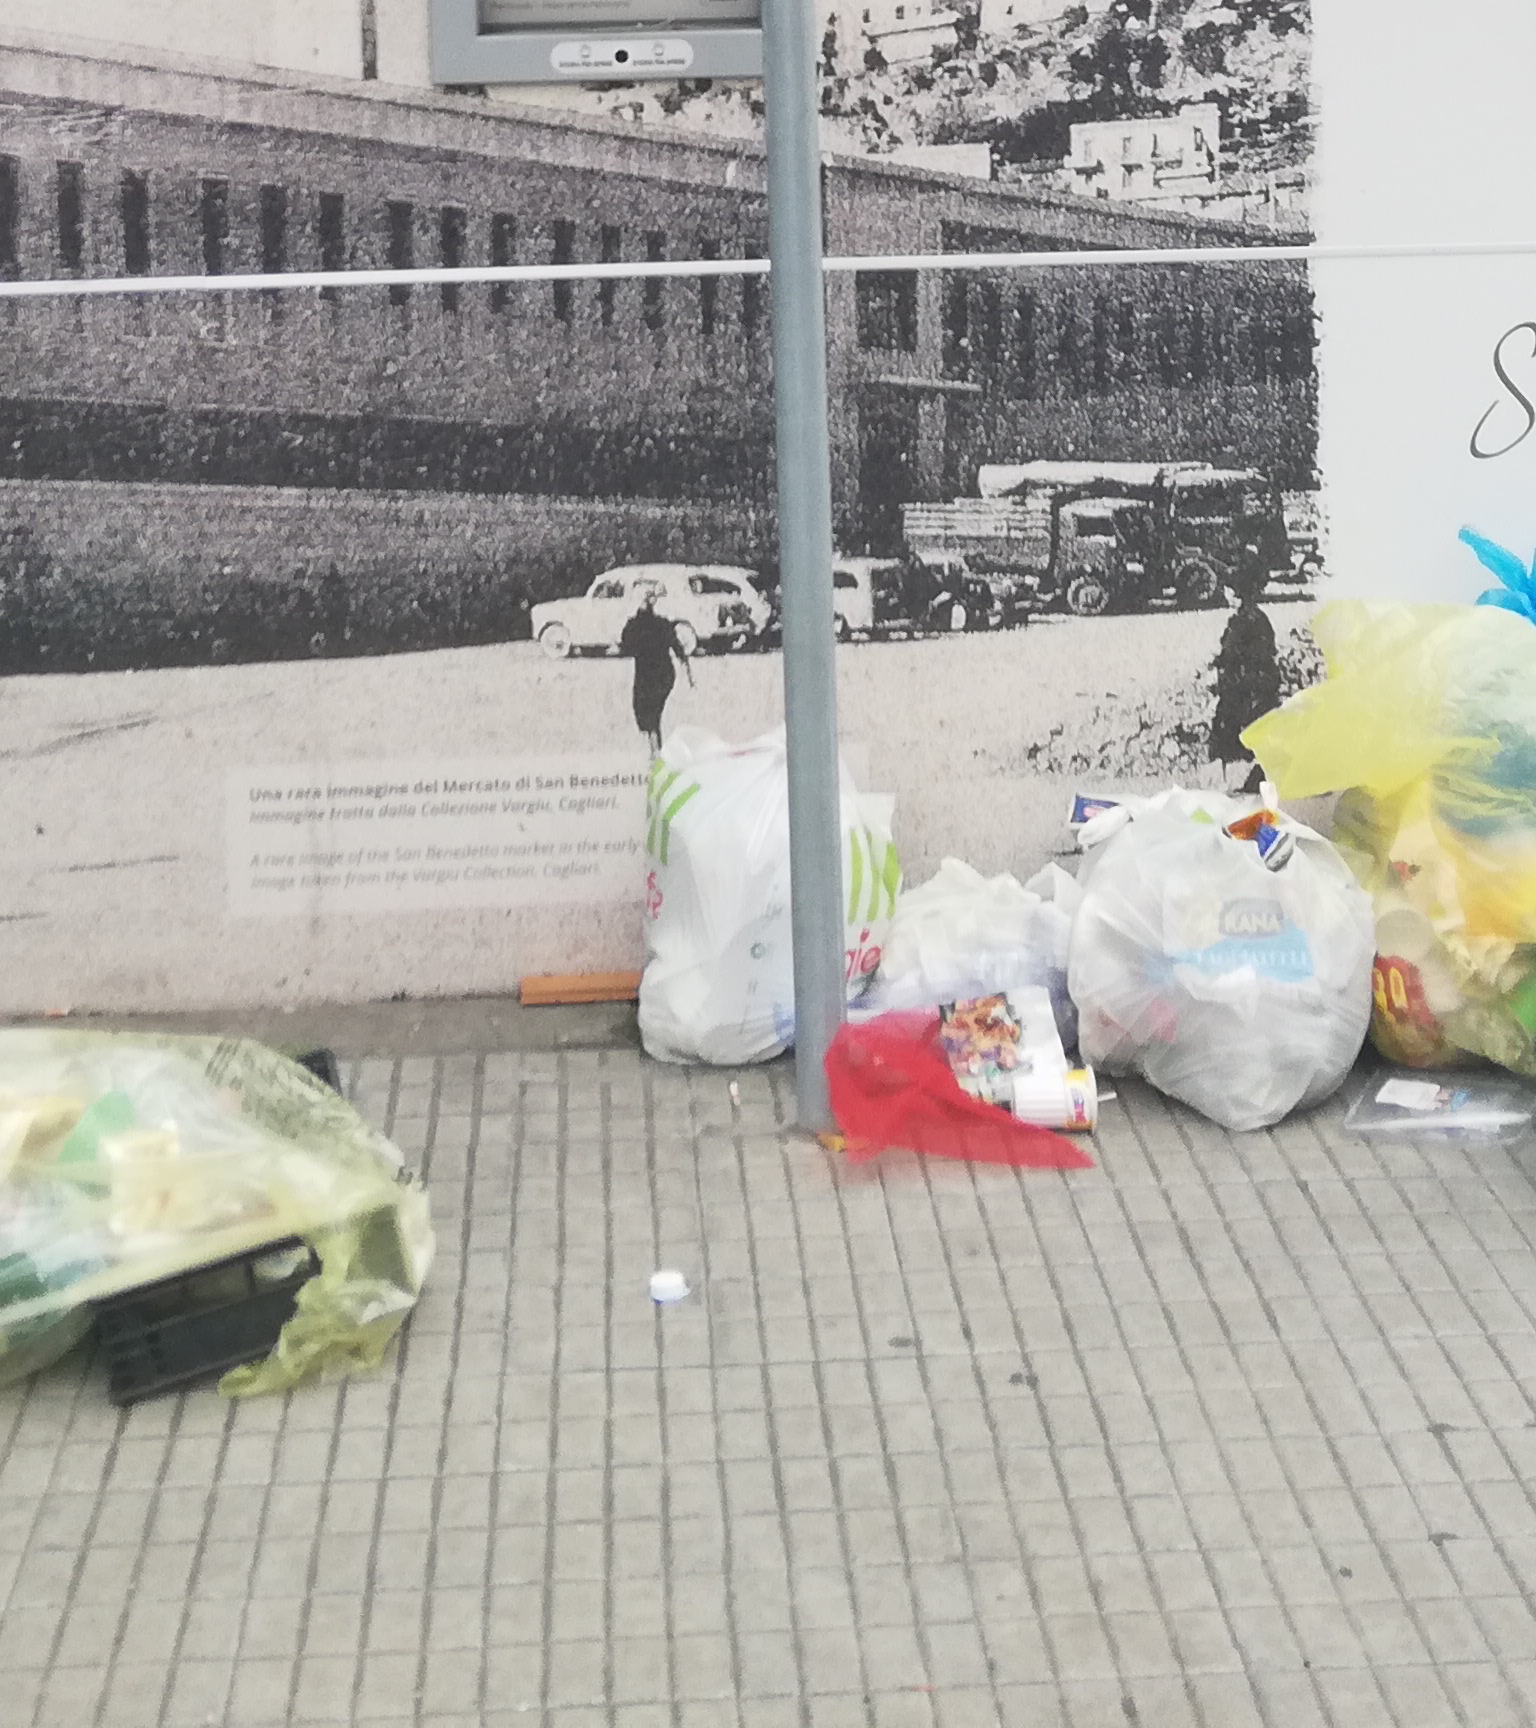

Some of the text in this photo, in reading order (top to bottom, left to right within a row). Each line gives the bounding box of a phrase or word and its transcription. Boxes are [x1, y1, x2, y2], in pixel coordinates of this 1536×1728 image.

[413, 778, 439, 794] del
[442, 777, 512, 793] Mercato
[515, 775, 531, 791] di
[535, 775, 565, 789] San
